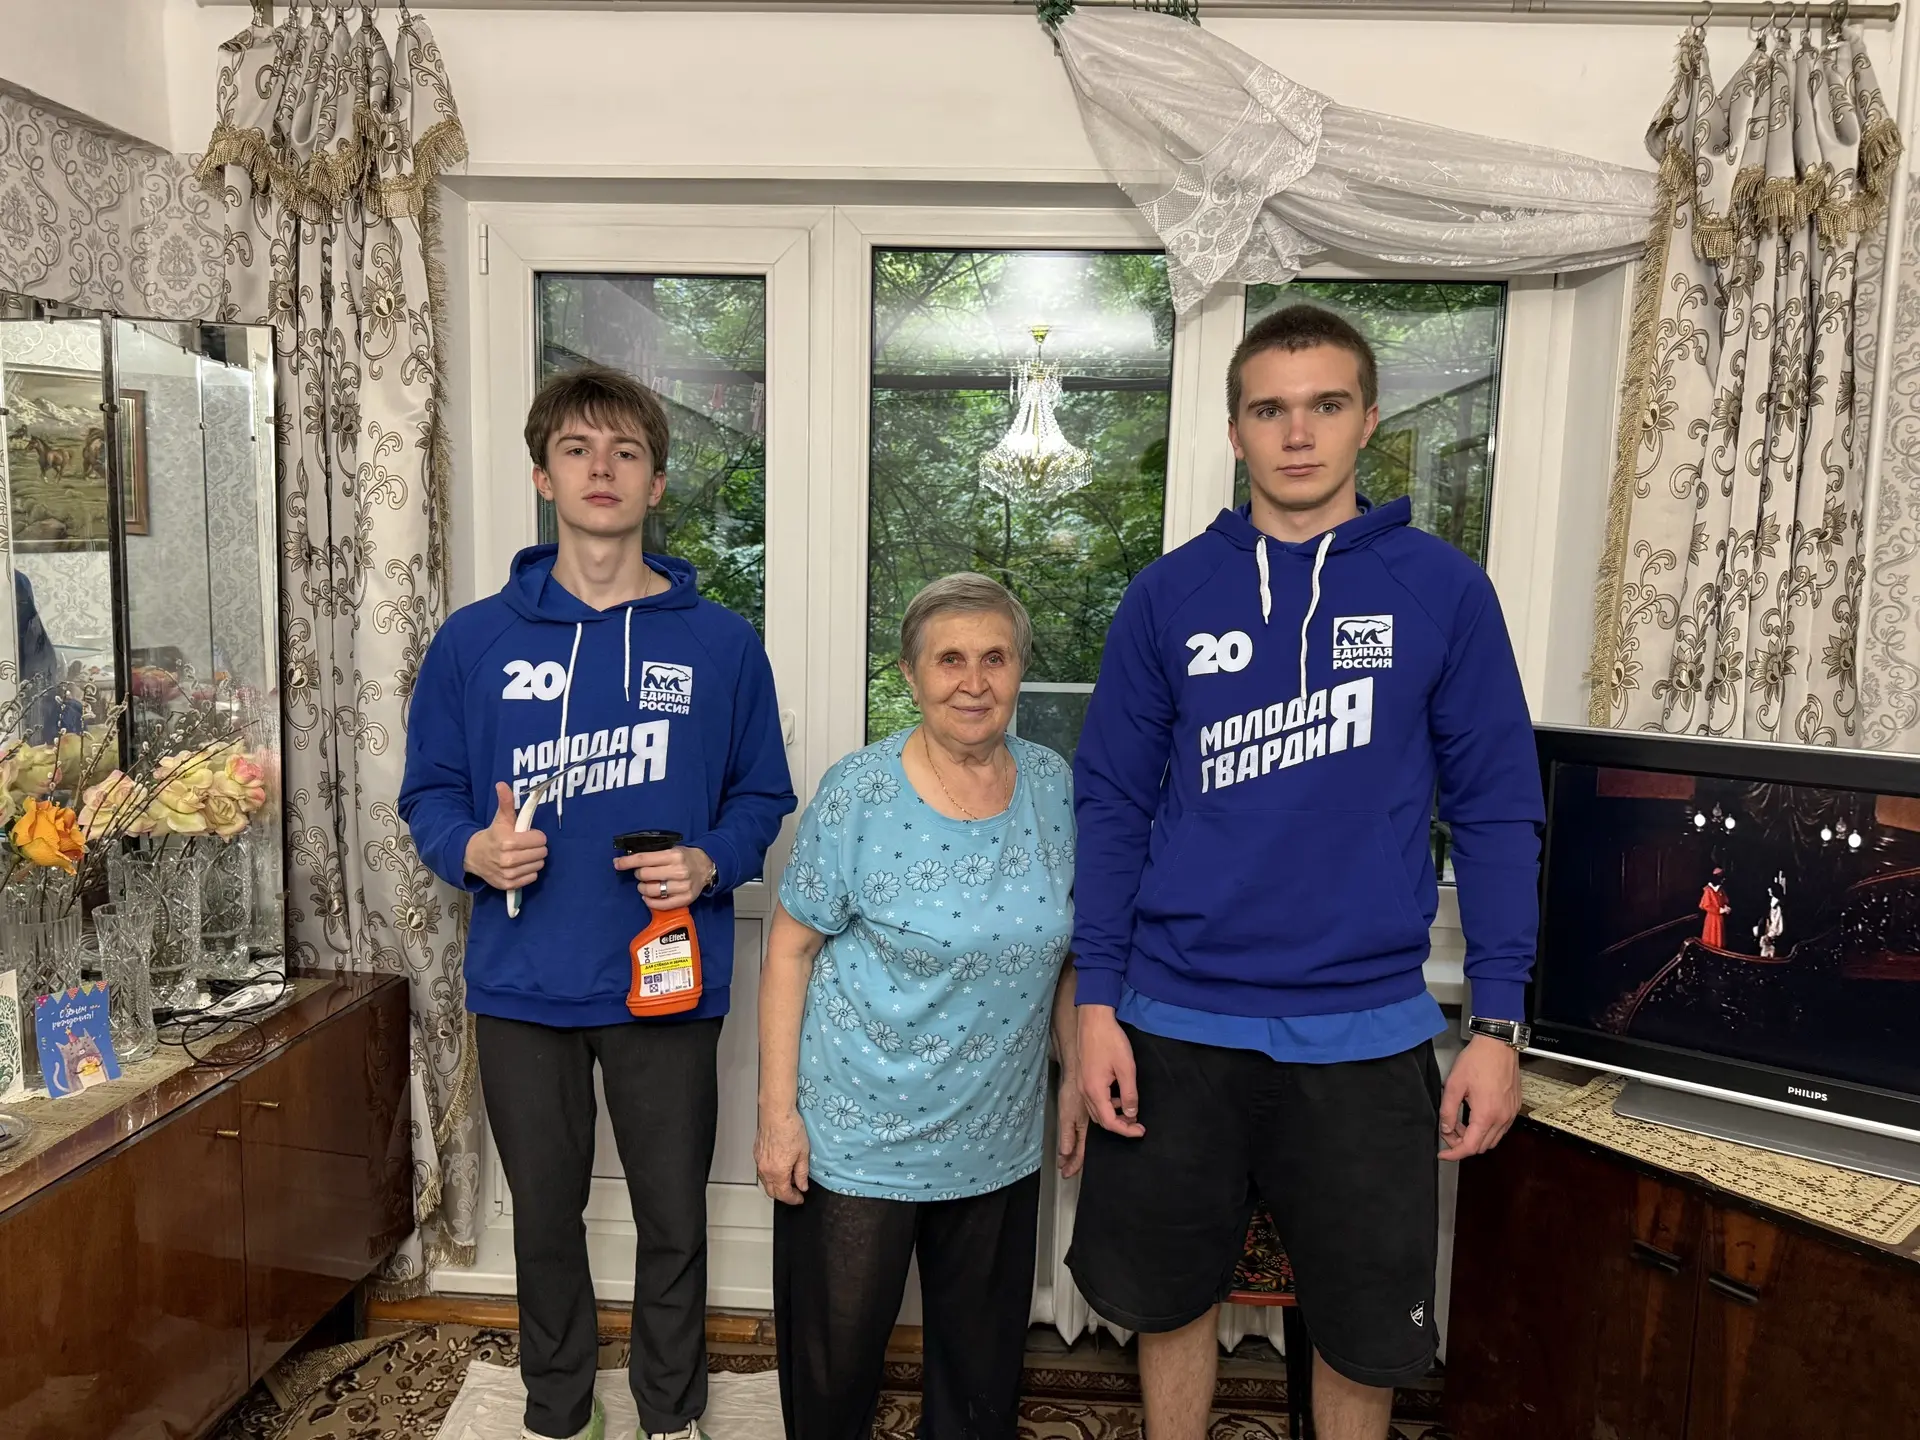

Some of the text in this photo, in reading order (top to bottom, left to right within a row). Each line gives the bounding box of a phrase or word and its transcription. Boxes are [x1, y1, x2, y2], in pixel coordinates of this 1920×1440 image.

[1185, 630, 1253, 676] 20
[1333, 647, 1392, 659] ЕДИНАЯ
[1333, 658, 1392, 670] РОССИЯ
[502, 660, 567, 702] 20
[639, 690, 691, 705] ЕДИНАЯ
[639, 701, 690, 715] РОССИЯ
[1200, 676, 1374, 757] МОЛОДАЯ
[1788, 1086, 1828, 1102] PHILIPS
